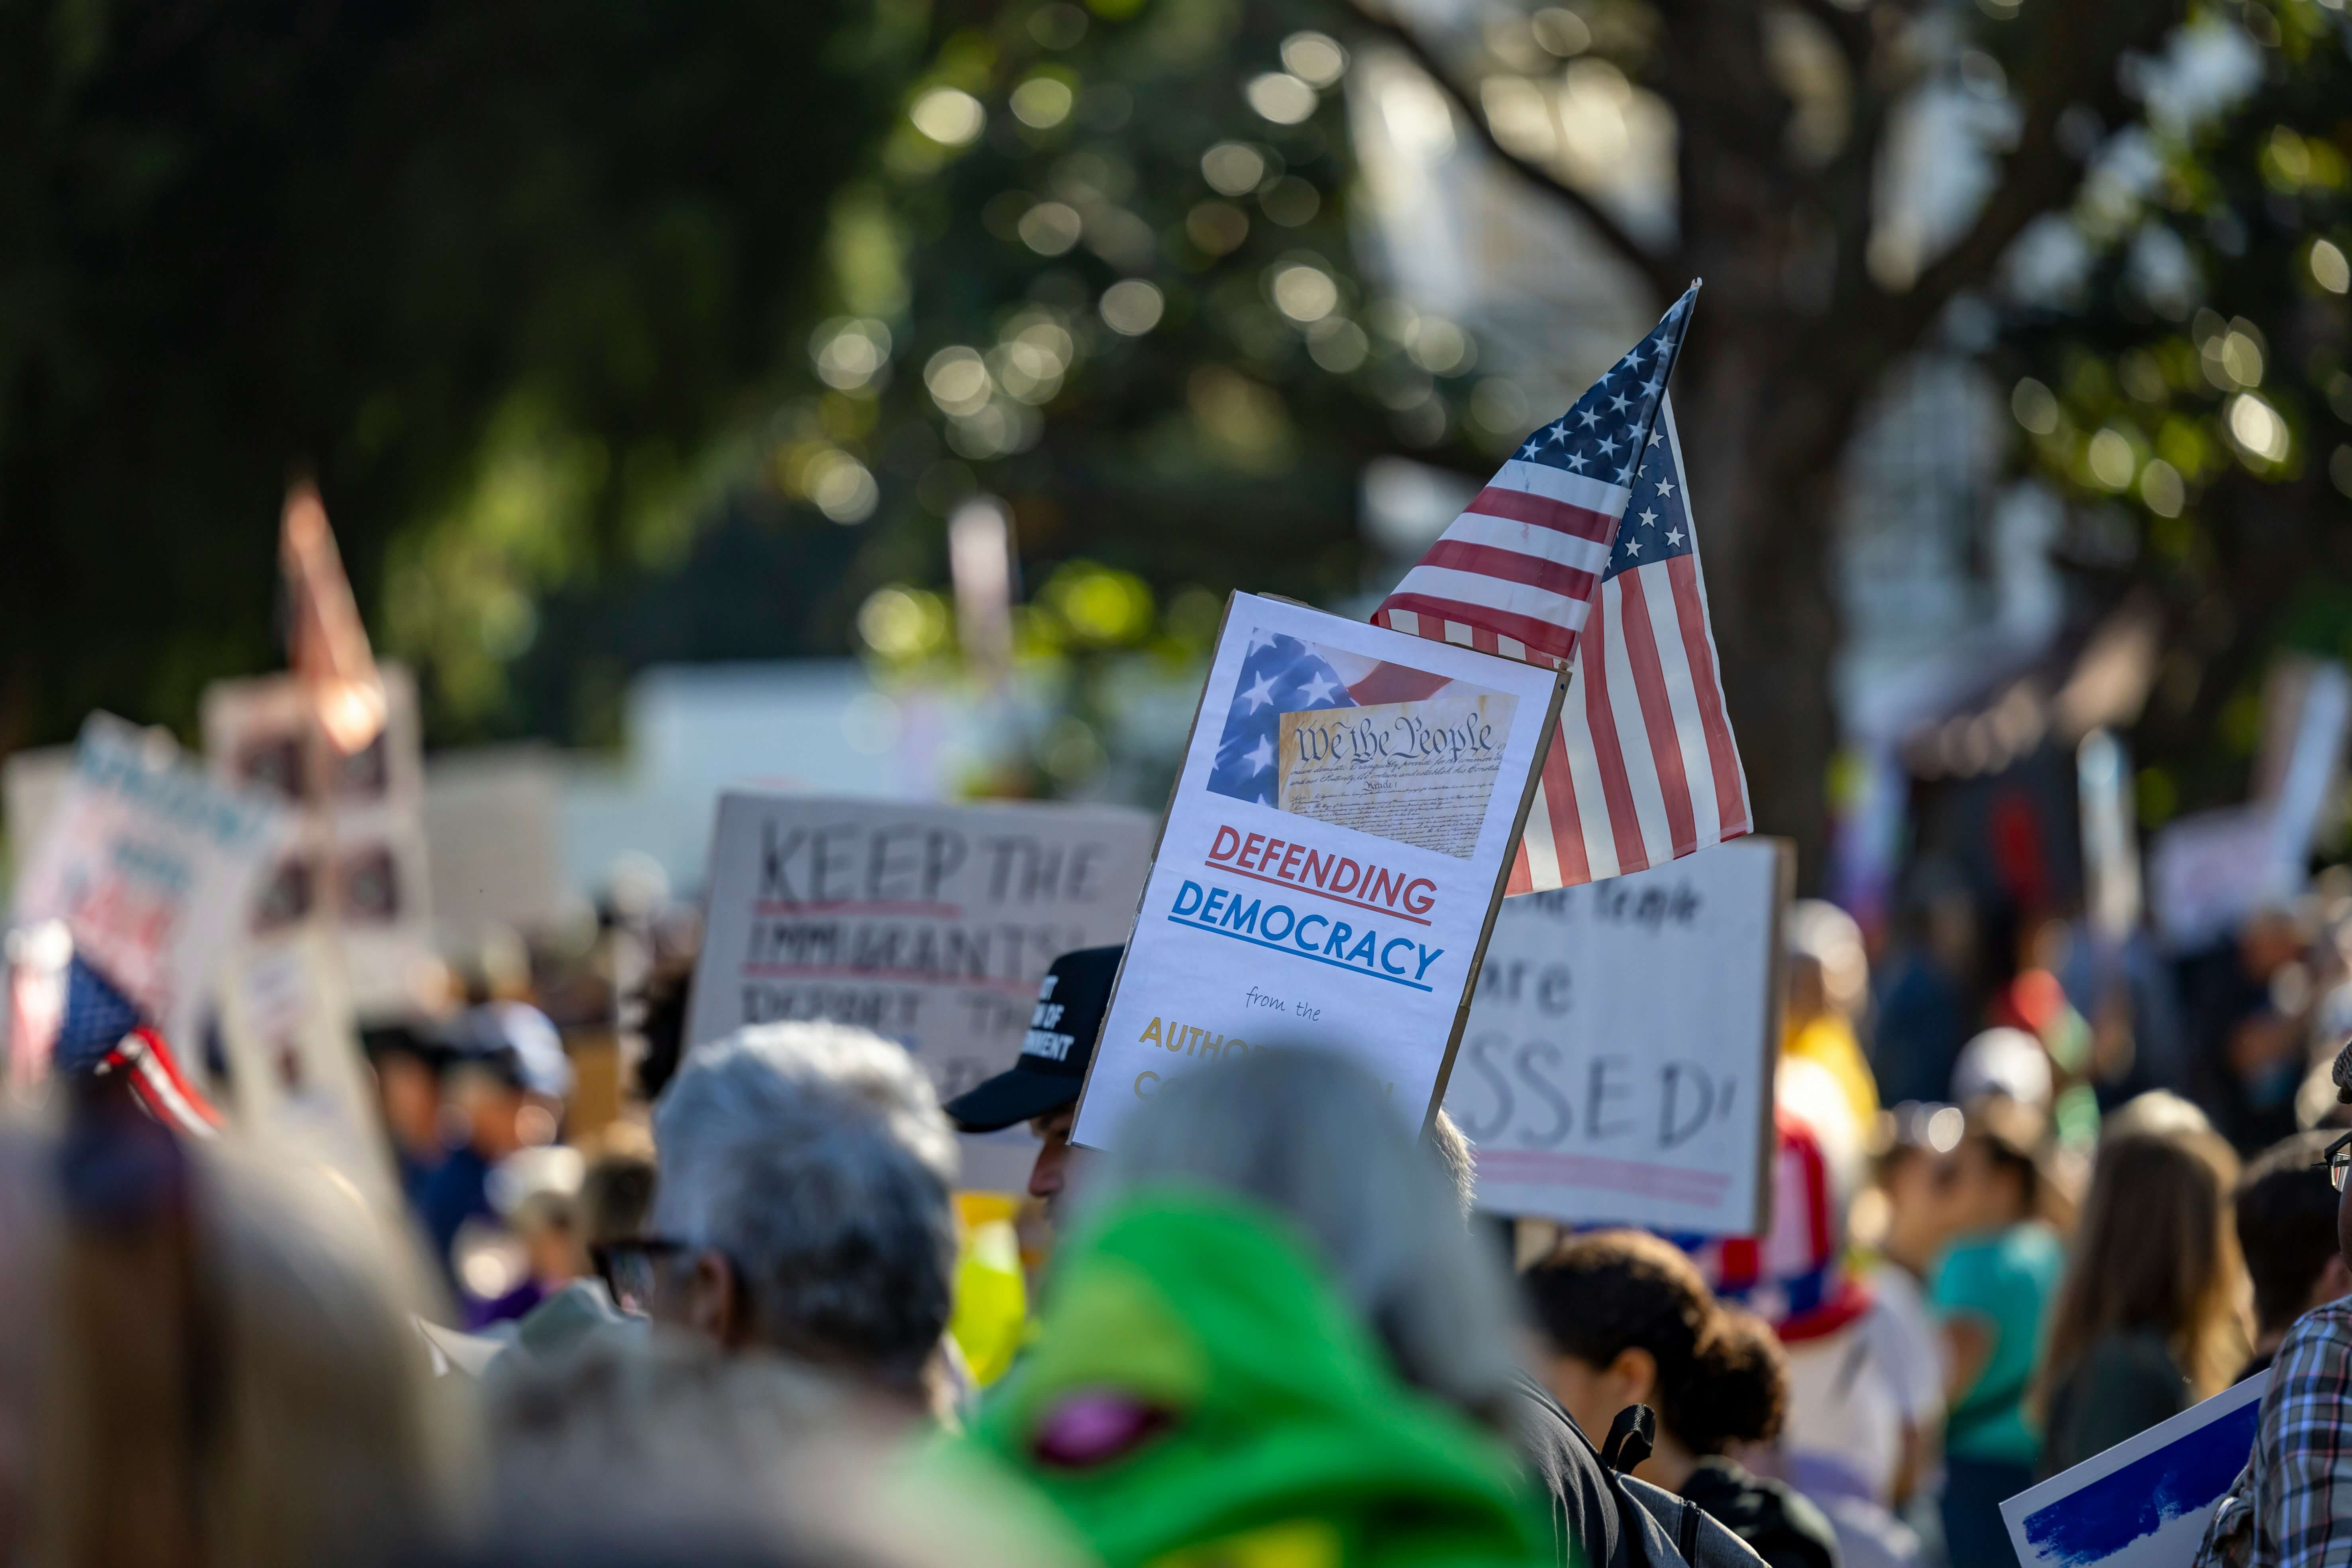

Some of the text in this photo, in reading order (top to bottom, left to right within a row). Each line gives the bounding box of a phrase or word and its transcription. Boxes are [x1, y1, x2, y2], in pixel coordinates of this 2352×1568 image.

[1293, 712, 1497, 768] We the People
[1313, 763, 1348, 773] domestic
[757, 816, 1112, 907] KEEP THE
[1208, 824, 1438, 915] DEFENDING
[1171, 879, 1445, 981] DEMOCRACY
[1246, 986, 1321, 1021] from the
[1139, 1017, 1267, 1061] AUTHO
